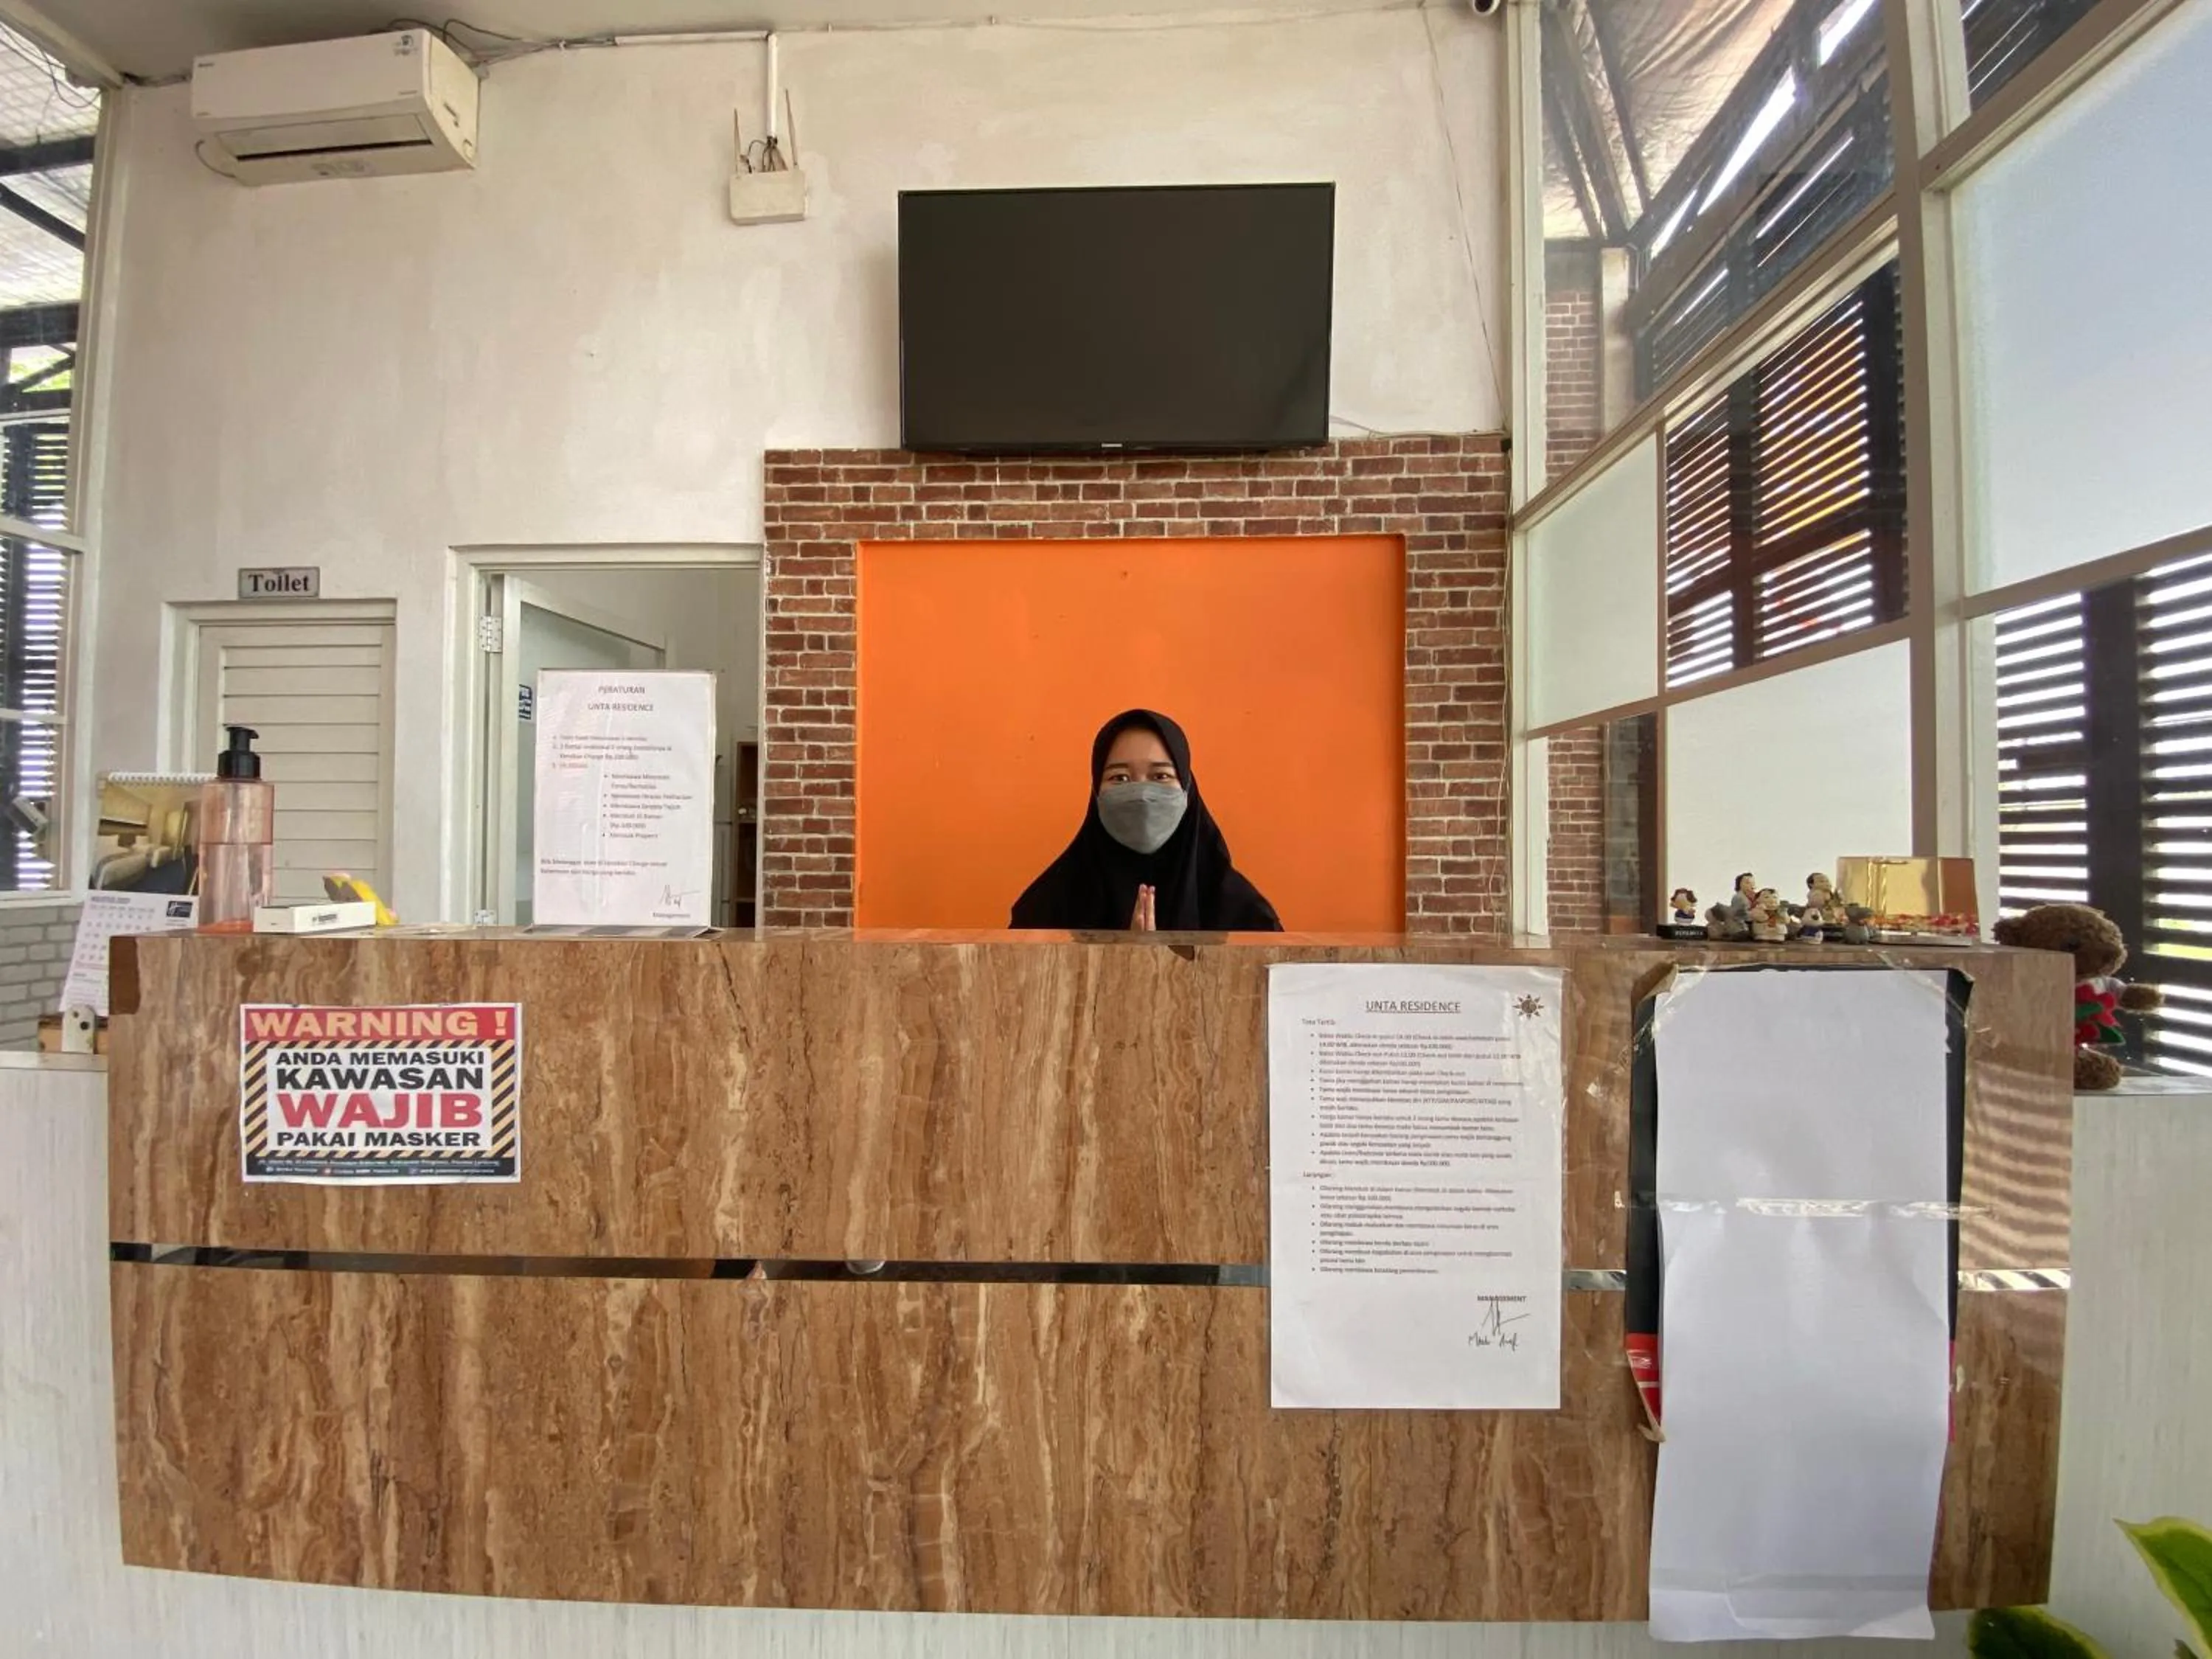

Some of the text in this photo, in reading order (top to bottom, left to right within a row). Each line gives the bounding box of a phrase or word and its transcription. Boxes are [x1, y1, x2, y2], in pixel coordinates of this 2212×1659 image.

[248, 574, 309, 592] Toilet
[1366, 1000, 1461, 1012] UNTA RESIDENCE
[250, 1011, 507, 1037] WARNING !
[276, 1051, 484, 1065] ANDA MEMASUKI
[276, 1068, 484, 1090] KAWASAN
[276, 1093, 483, 1129] WAJIB
[276, 1132, 481, 1147] PAKAI MASKER
